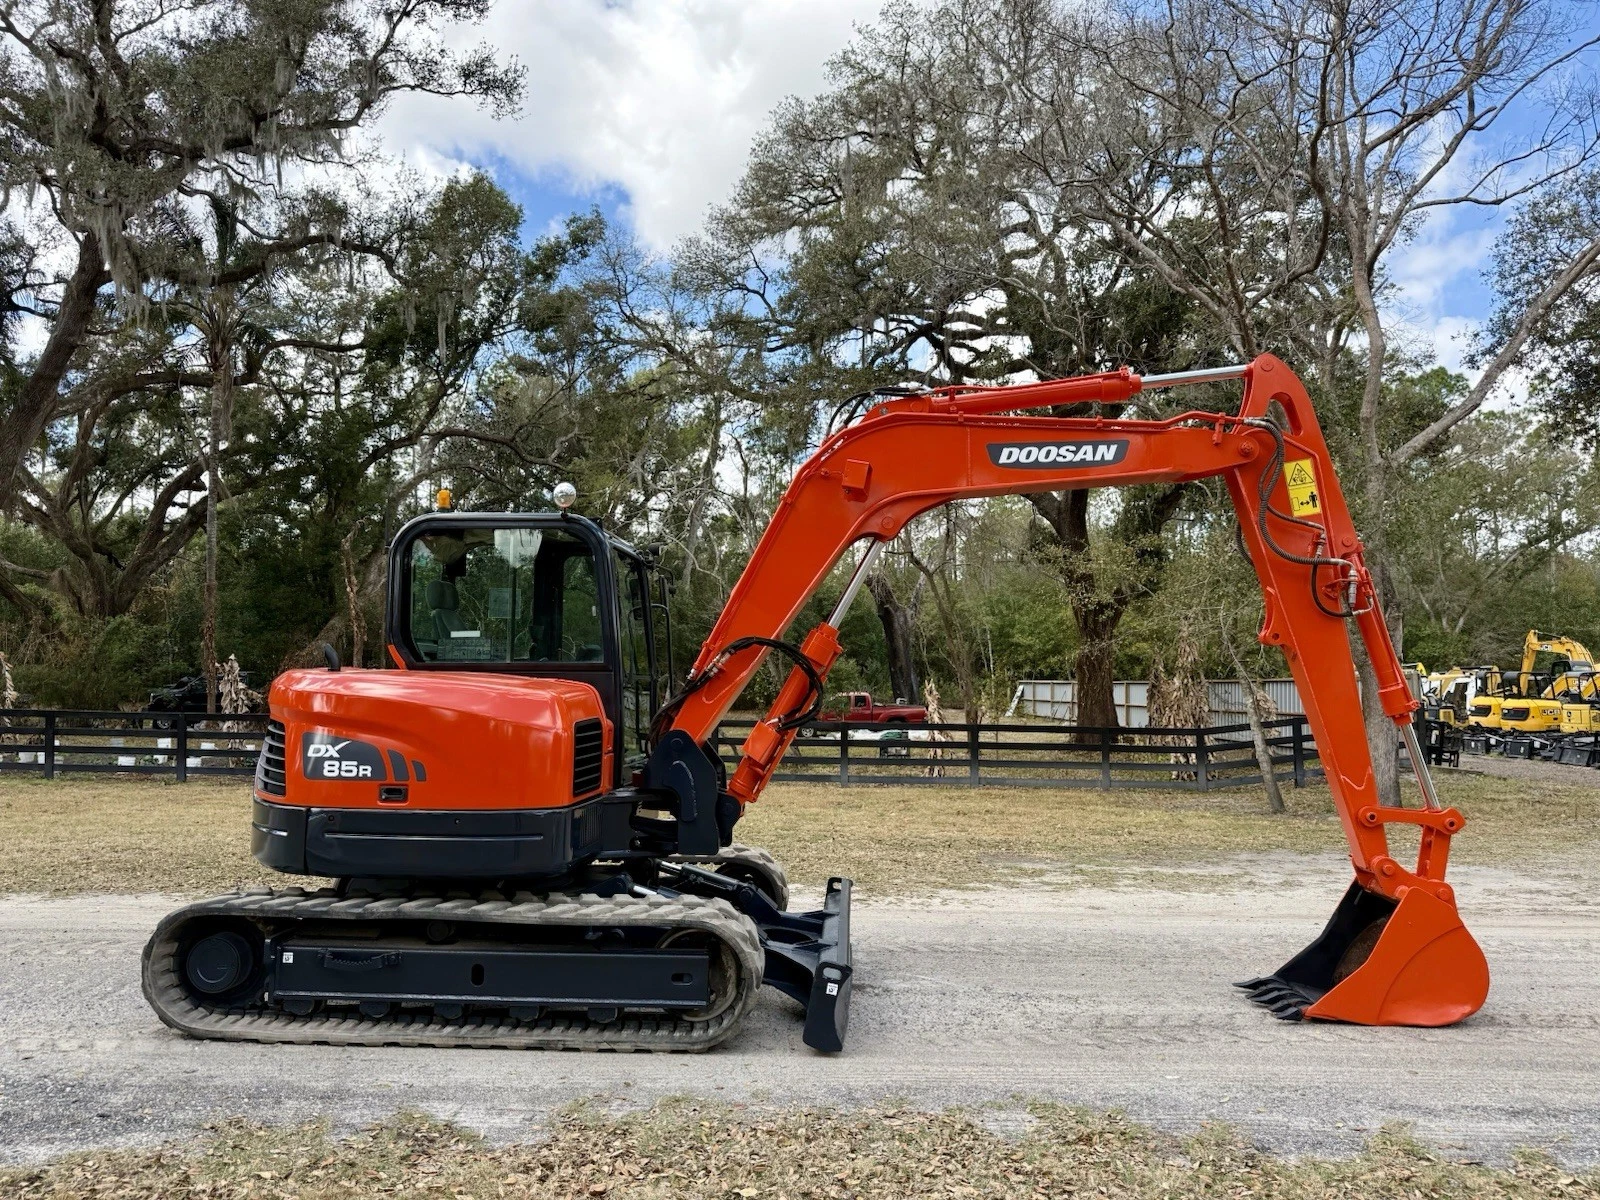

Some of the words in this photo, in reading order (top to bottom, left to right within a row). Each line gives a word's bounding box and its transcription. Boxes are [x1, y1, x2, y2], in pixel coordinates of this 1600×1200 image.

[998, 444, 1118, 464] DOOSAN
[307, 740, 352, 758] DX
[323, 760, 372, 777] 85R
